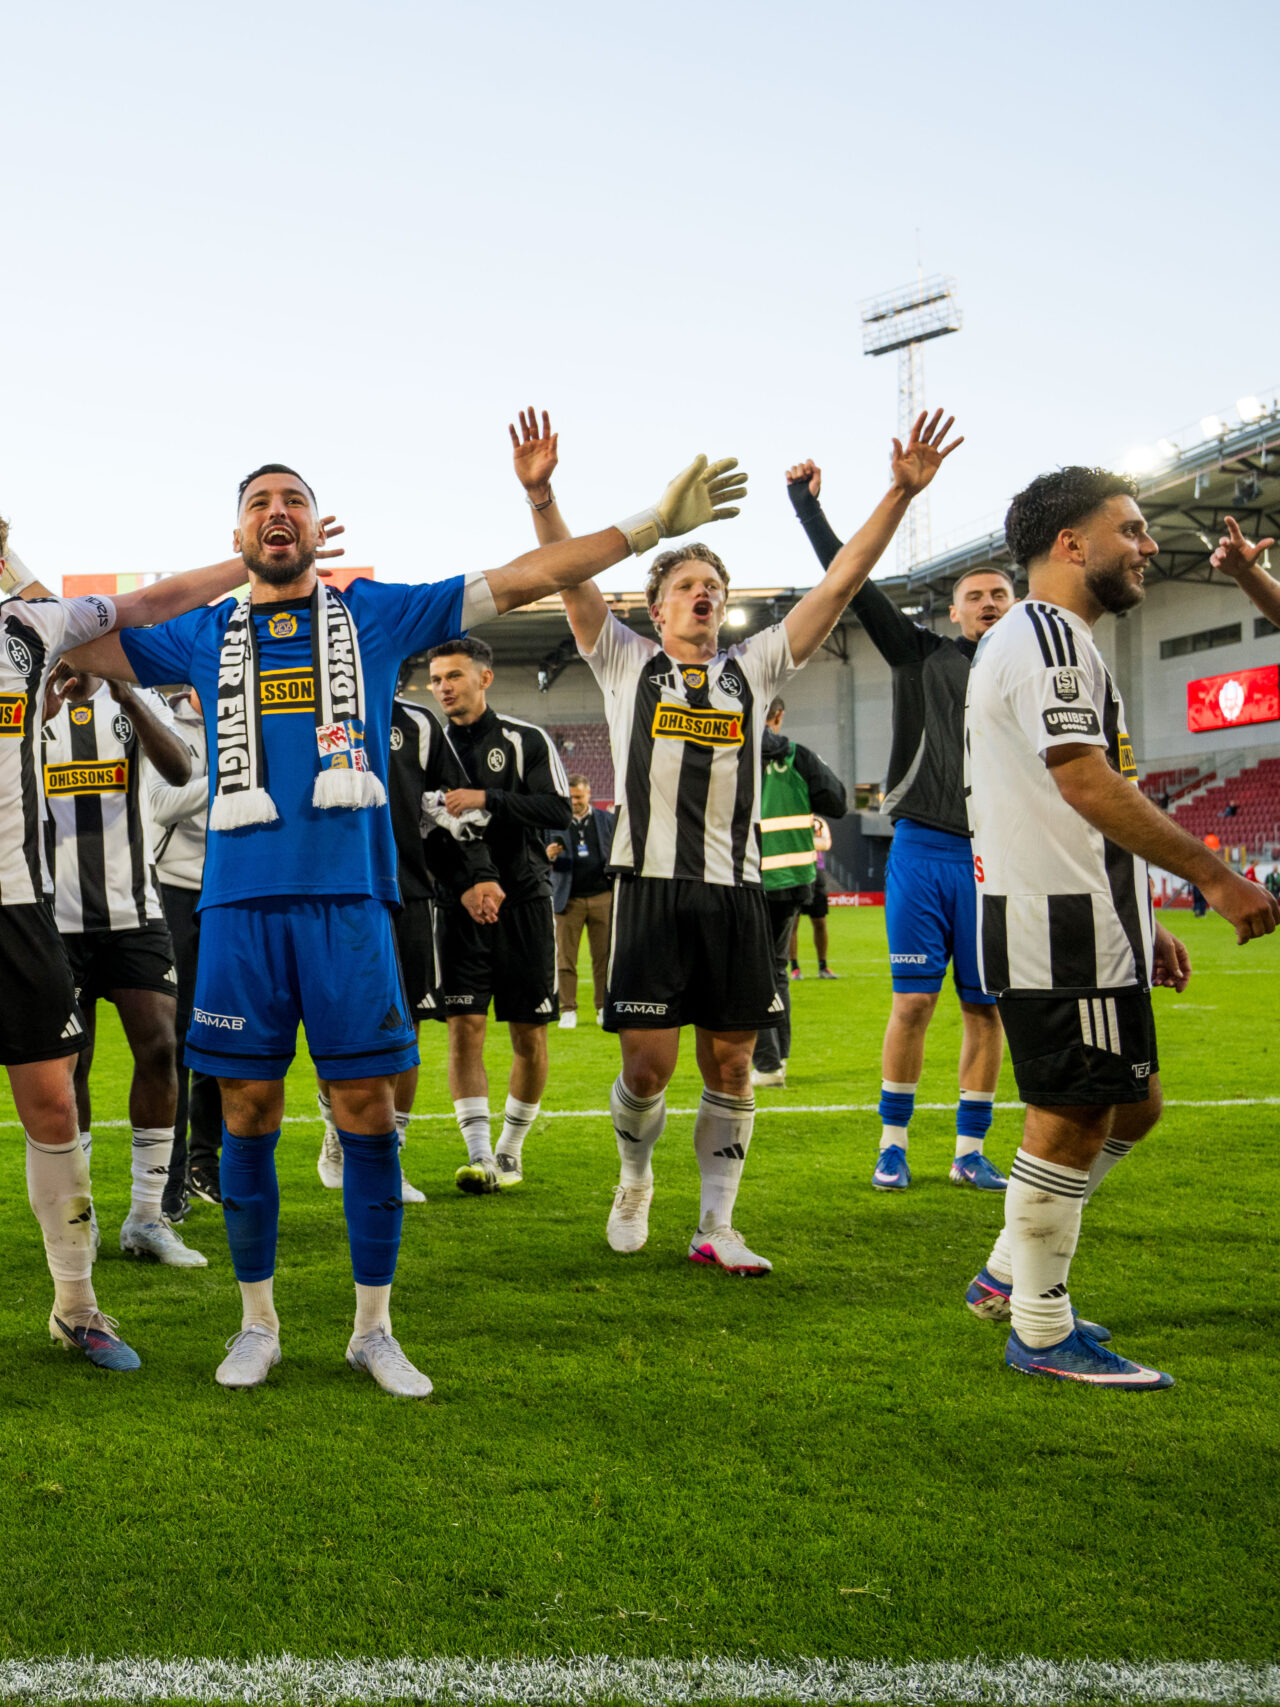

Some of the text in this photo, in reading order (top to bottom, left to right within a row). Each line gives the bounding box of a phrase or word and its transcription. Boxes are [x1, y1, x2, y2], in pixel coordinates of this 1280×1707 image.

[218, 628, 251, 688] FÖR
[658, 713, 729, 737] OHLSSONS
[1046, 711, 1093, 725] UNIBET
[217, 694, 250, 788] EVIGT
[49, 770, 114, 787] OHLSSONS
